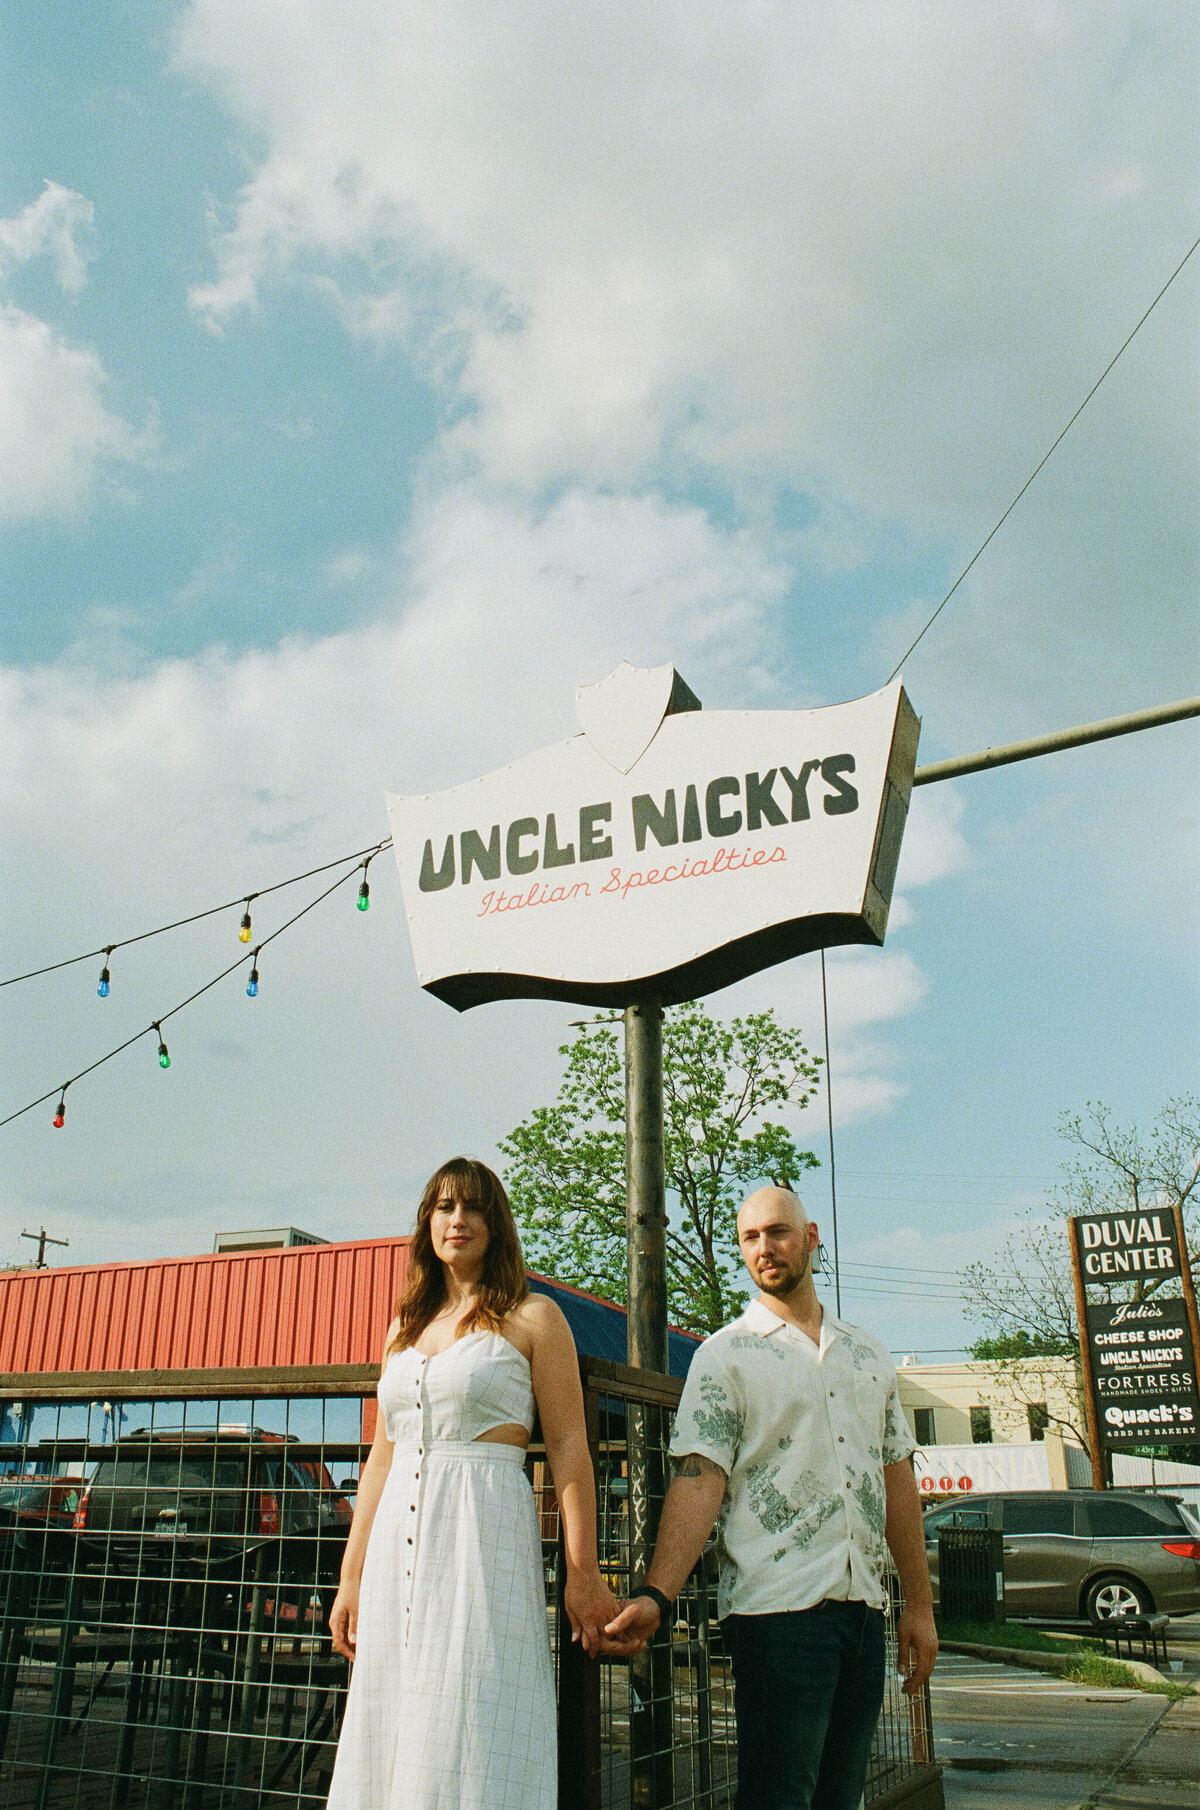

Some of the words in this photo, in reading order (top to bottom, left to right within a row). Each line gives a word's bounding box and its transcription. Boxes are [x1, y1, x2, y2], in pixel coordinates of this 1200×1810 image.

[418, 801, 614, 893] UNCLE
[631, 753, 860, 852] NICKY'S
[477, 879, 592, 918] Italian
[600, 846, 788, 900] Specialties
[1082, 1217, 1171, 1248] DUVAL
[1085, 1247, 1174, 1274] CENTER
[1109, 1303, 1164, 1326] Julio's
[1094, 1331, 1146, 1345] CHEESE
[1148, 1328, 1184, 1342] SHOP
[1101, 1350, 1140, 1365] UNCLE
[1097, 1373, 1193, 1390] FORTRESS
[1105, 1404, 1193, 1428] Quack's
[1154, 1427, 1196, 1436] BAKERY
